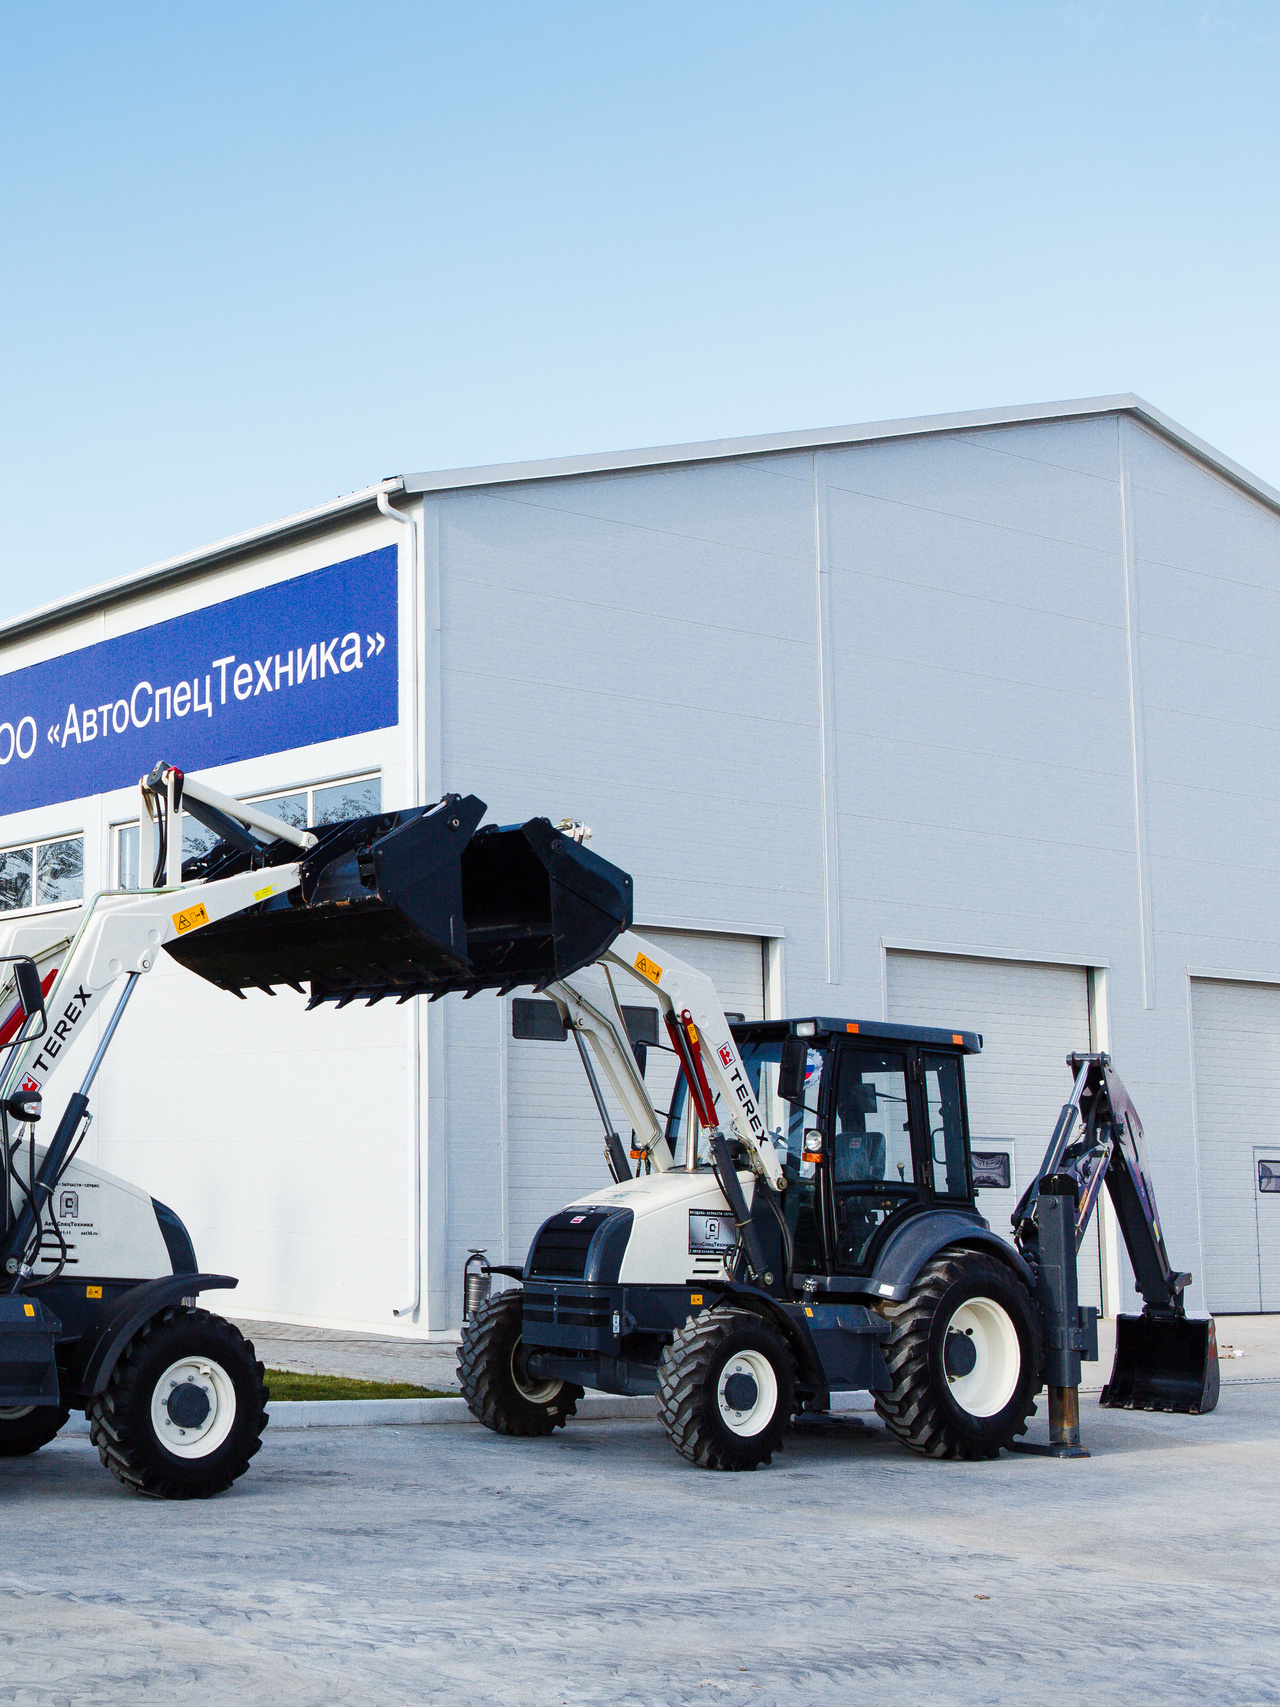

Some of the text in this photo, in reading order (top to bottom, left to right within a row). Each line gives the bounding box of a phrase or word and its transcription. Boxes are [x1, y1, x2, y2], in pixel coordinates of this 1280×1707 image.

[47, 631, 385, 748] «АвтоСпецТехника»
[32, 984, 93, 1072] TEREX
[730, 1067, 769, 1148] TEREX
[44, 1220, 94, 1228] АвтСпецТехника
